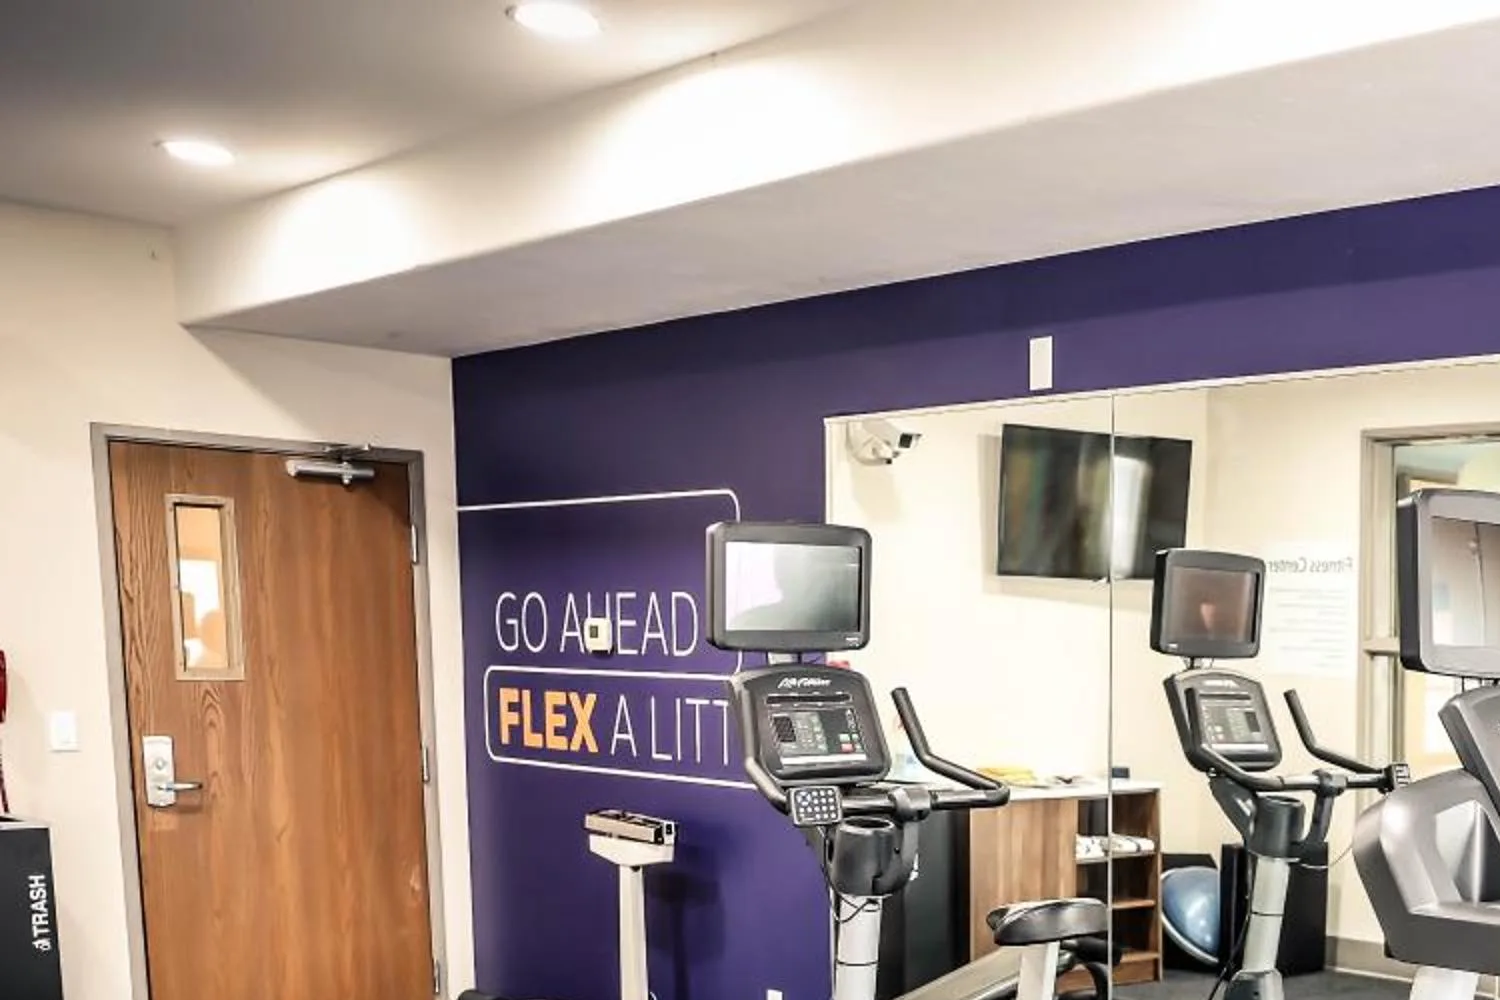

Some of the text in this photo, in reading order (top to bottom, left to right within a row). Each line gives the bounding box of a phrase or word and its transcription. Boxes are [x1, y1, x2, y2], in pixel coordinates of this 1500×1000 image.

[496, 591, 547, 653] GO
[499, 687, 599, 753] FLEX
[610, 694, 637, 757] A
[28, 874, 51, 938] TRASH
